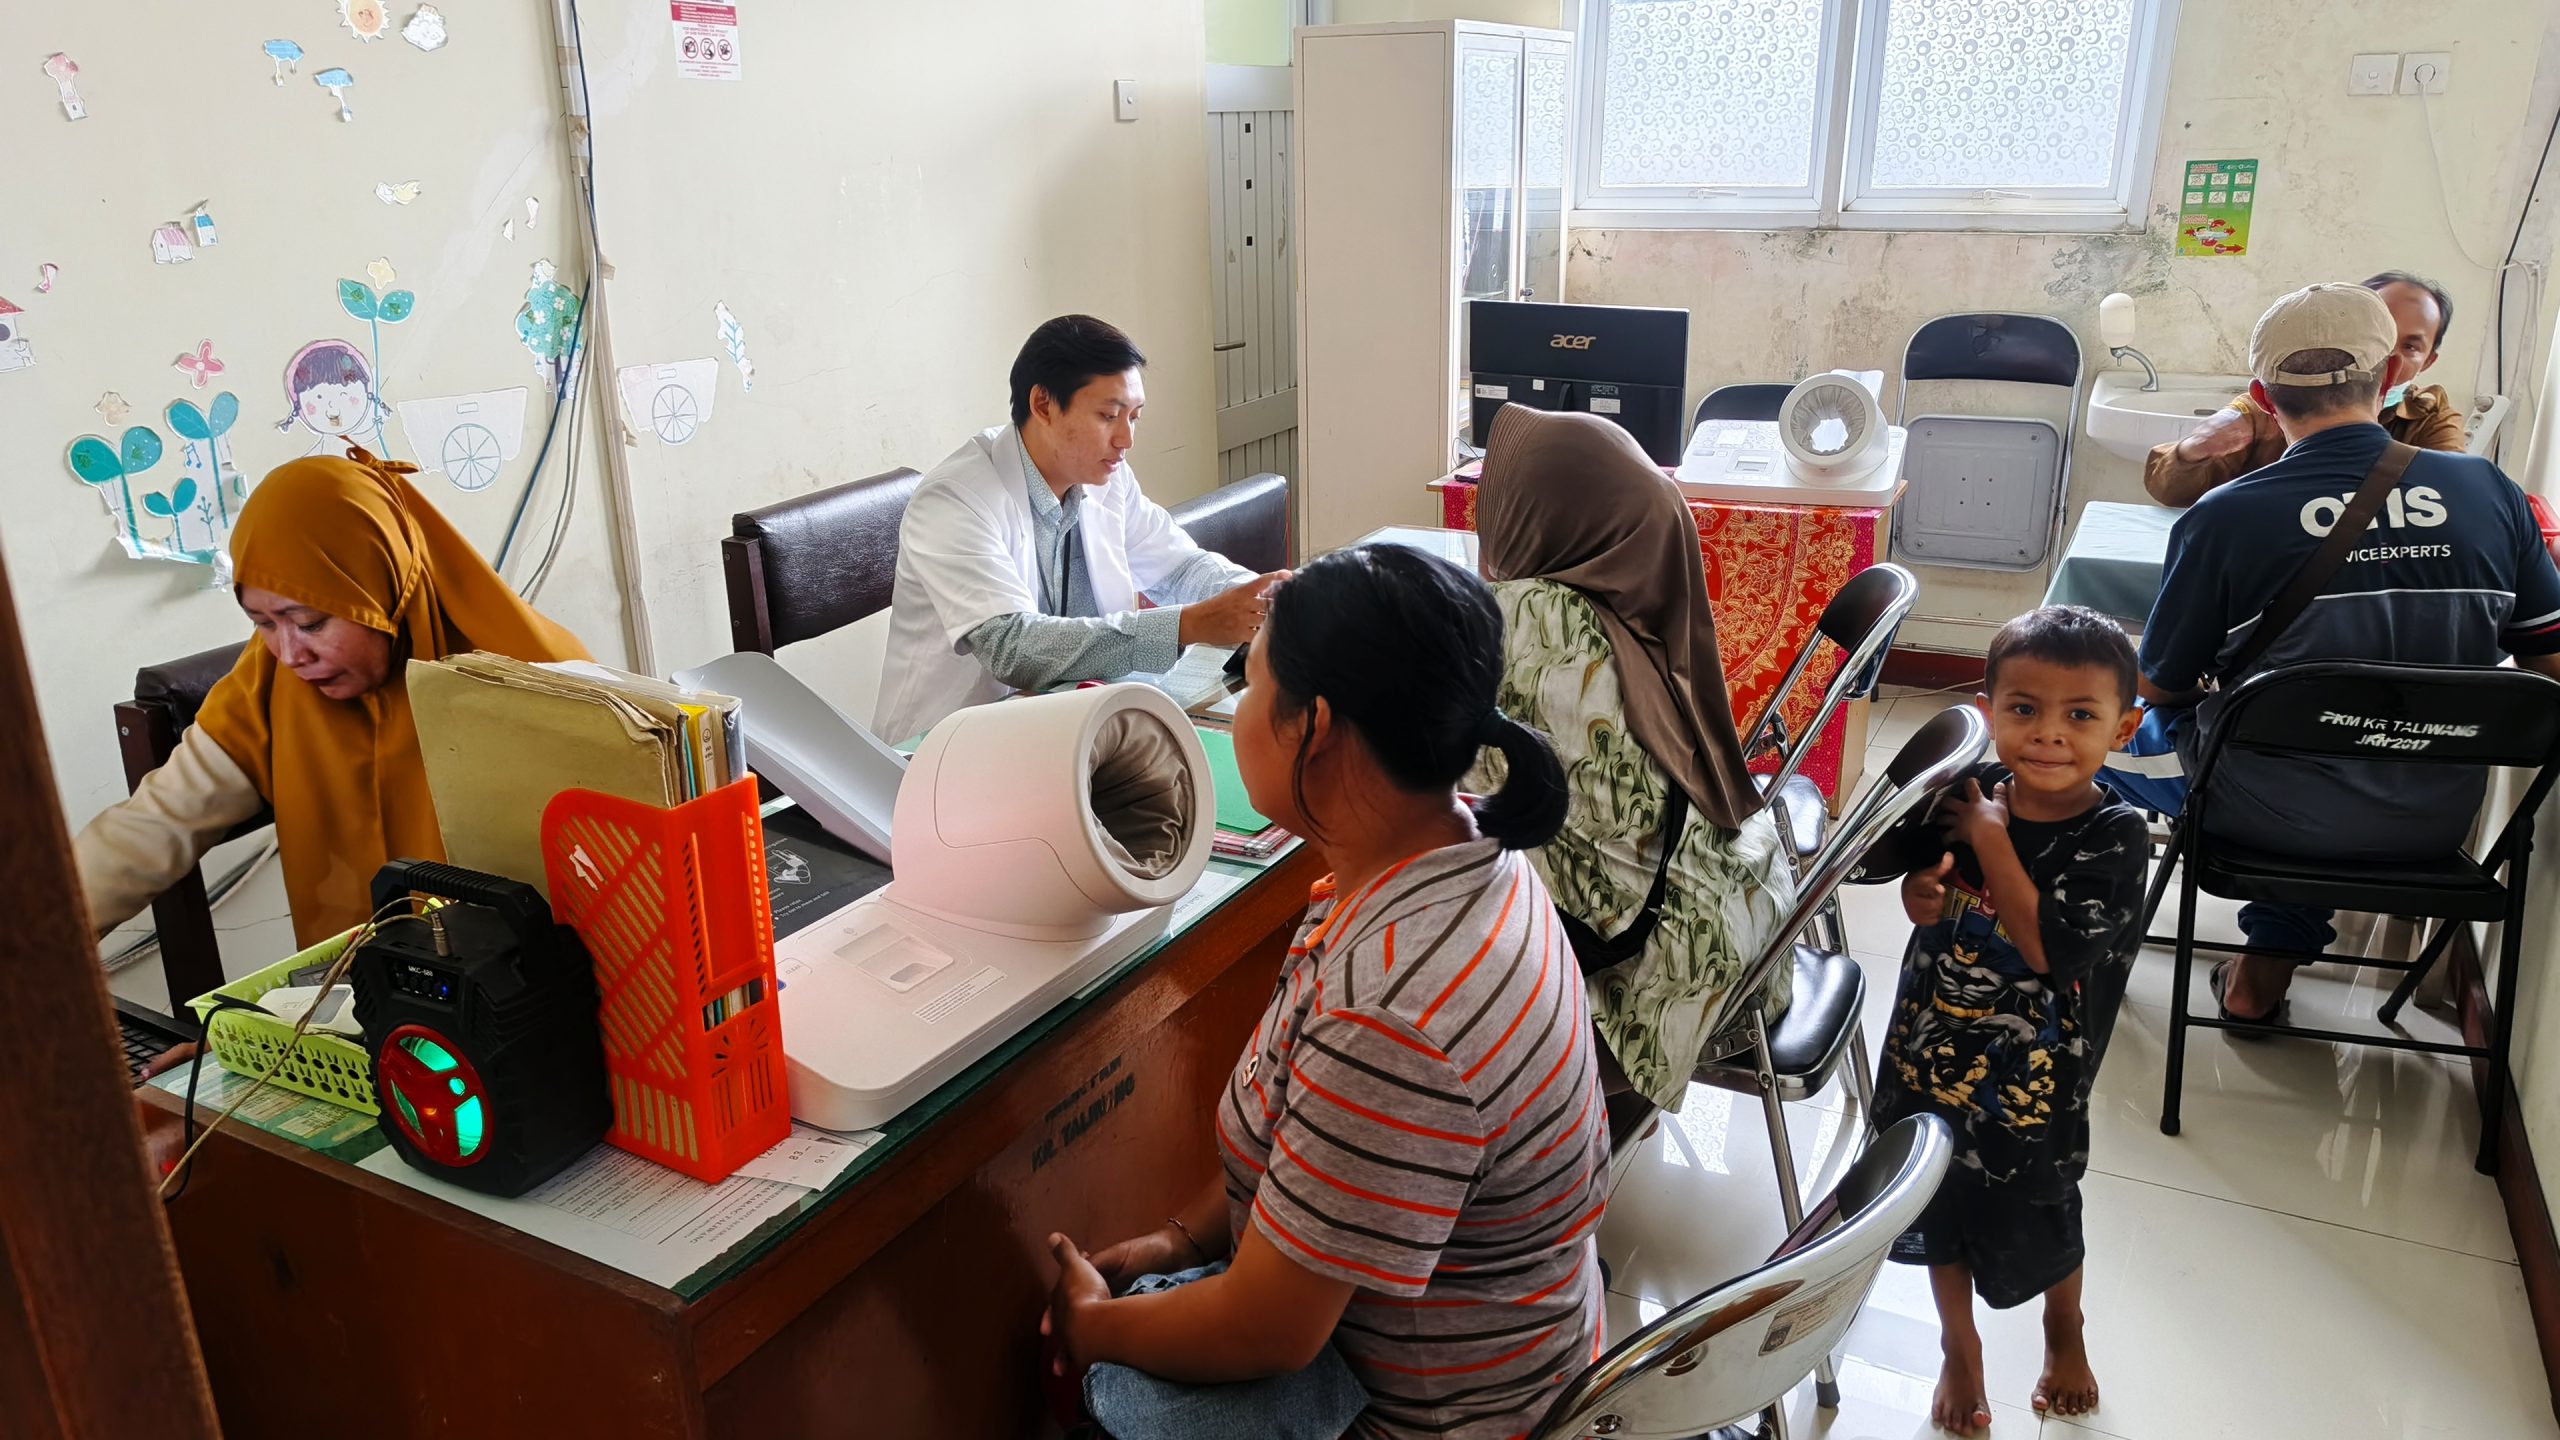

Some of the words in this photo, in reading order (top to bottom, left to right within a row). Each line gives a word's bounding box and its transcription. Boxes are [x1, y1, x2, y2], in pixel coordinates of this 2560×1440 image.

[1550, 333, 1597, 350] acer
[2300, 485, 2448, 538] OIS
[2319, 711, 2361, 727] PKM
[2393, 720, 2481, 738] TALIWANG
[788, 1149, 804, 1161] 83
[730, 1193, 762, 1217] KARANG
[690, 1214, 731, 1245] TALIWANG
